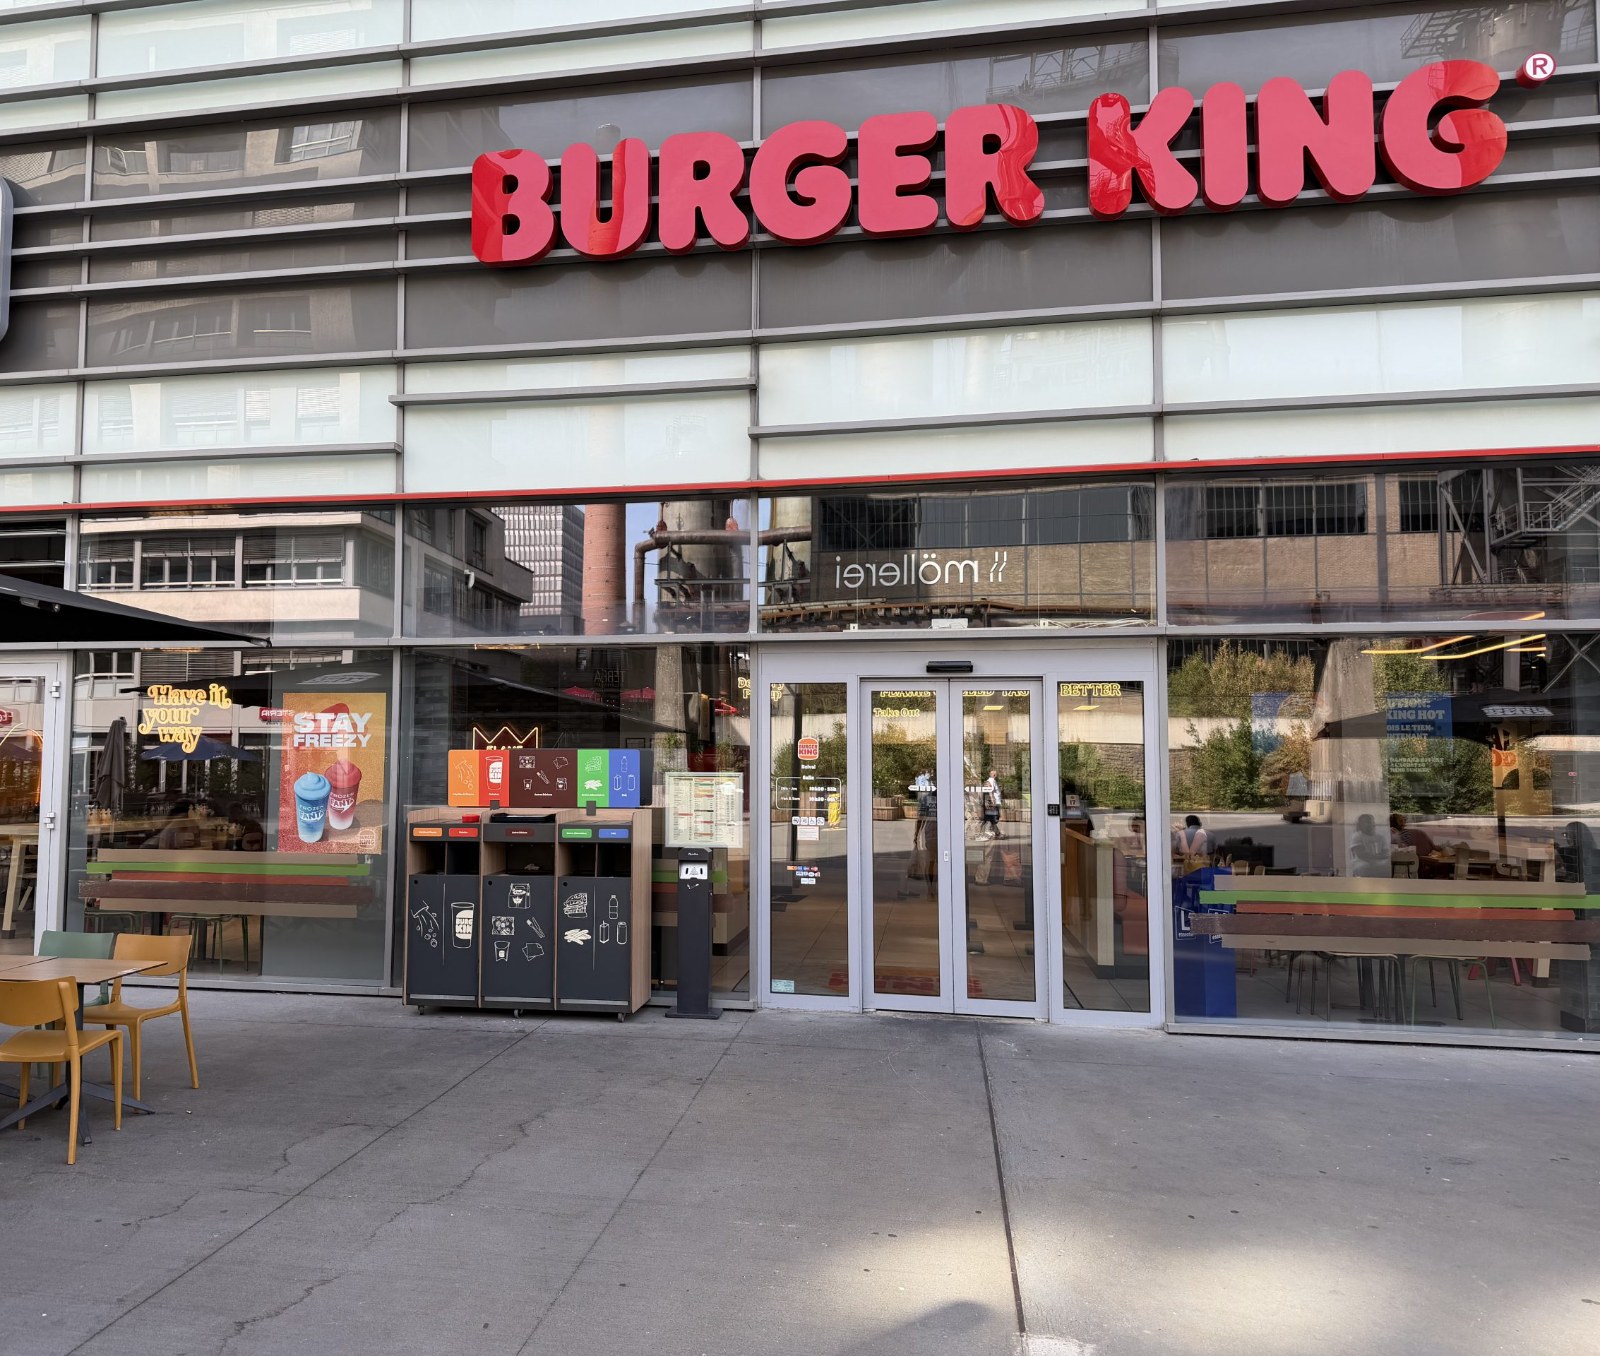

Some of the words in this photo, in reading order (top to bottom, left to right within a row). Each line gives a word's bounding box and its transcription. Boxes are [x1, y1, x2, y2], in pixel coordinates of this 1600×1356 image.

[471, 103, 1046, 266] BURGER
[1088, 59, 1508, 217] KING
[147, 684, 207, 706] Have
[208, 683, 232, 709] it
[1060, 683, 1121, 696] BETTER
[138, 707, 200, 735] your
[294, 712, 373, 733] STAY
[873, 707, 899, 717] Take
[900, 707, 920, 717] Out
[1417, 710, 1445, 719] HOT
[158, 726, 202, 753] way
[294, 734, 371, 748] FREEZY
